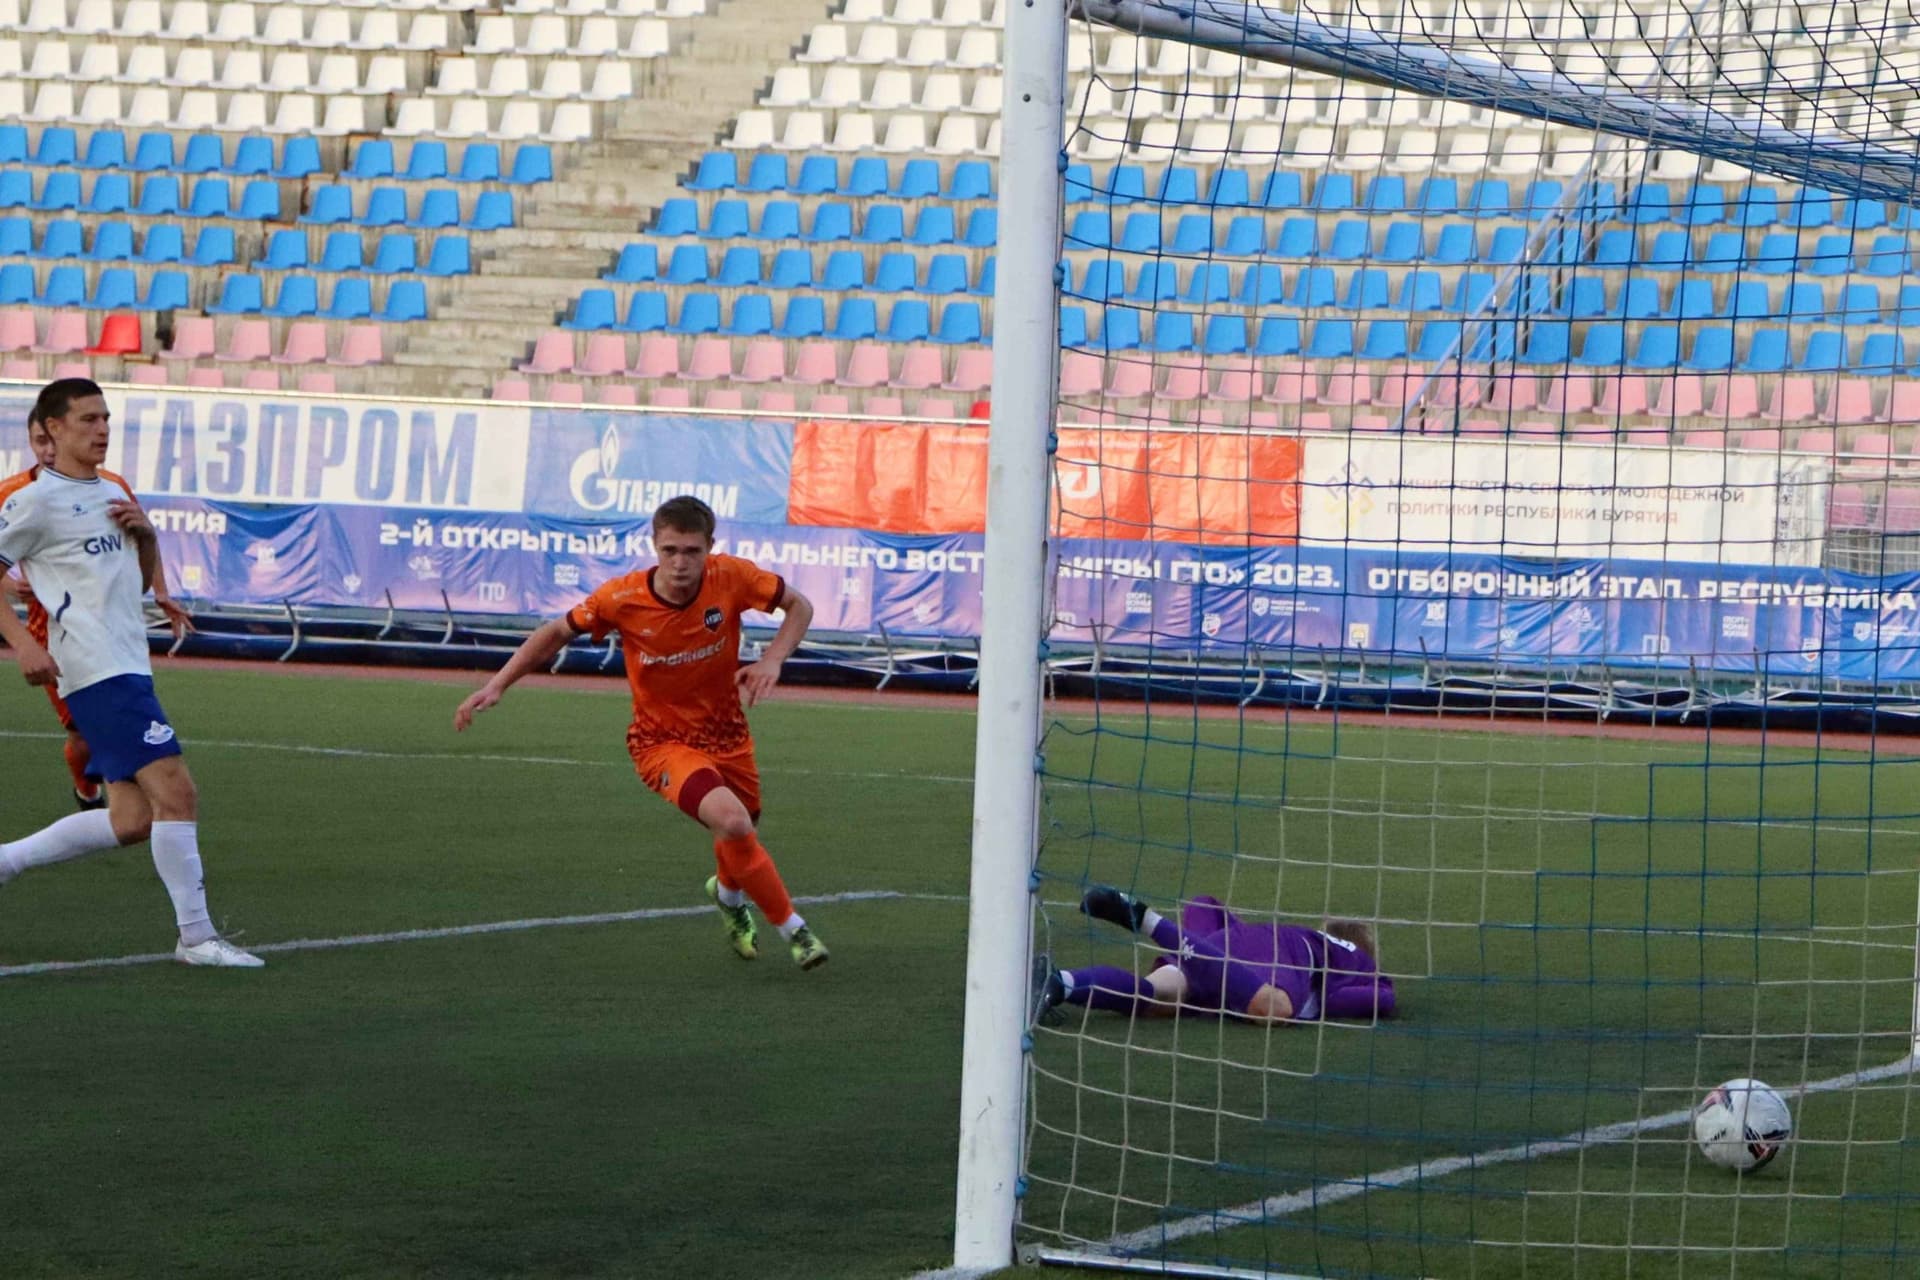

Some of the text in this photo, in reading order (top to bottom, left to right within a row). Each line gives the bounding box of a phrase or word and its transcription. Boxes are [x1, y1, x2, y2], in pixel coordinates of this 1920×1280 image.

[120, 396, 479, 507] ГАЗПРОМ
[148, 507, 228, 536] ЯТИЯ
[1386, 501, 1679, 524] ПОЛИТИКИ РЕСПУБЛИКИ БУРЯТИЯ
[83, 534, 122, 556] GNV
[379, 518, 434, 547] 2-Й
[441, 526, 617, 556] ОТКРЫТЫЙ
[736, 539, 898, 570] ДАЛЬНЕГО
[1170, 560, 1246, 585] ГТО»
[1252, 563, 1341, 588] 2023.
[1367, 566, 1592, 599] ОТБОРОЧНЫЙ
[1599, 575, 1689, 599] ЭТАП.
[1699, 580, 1918, 611] РЕСПУБЛИКА
